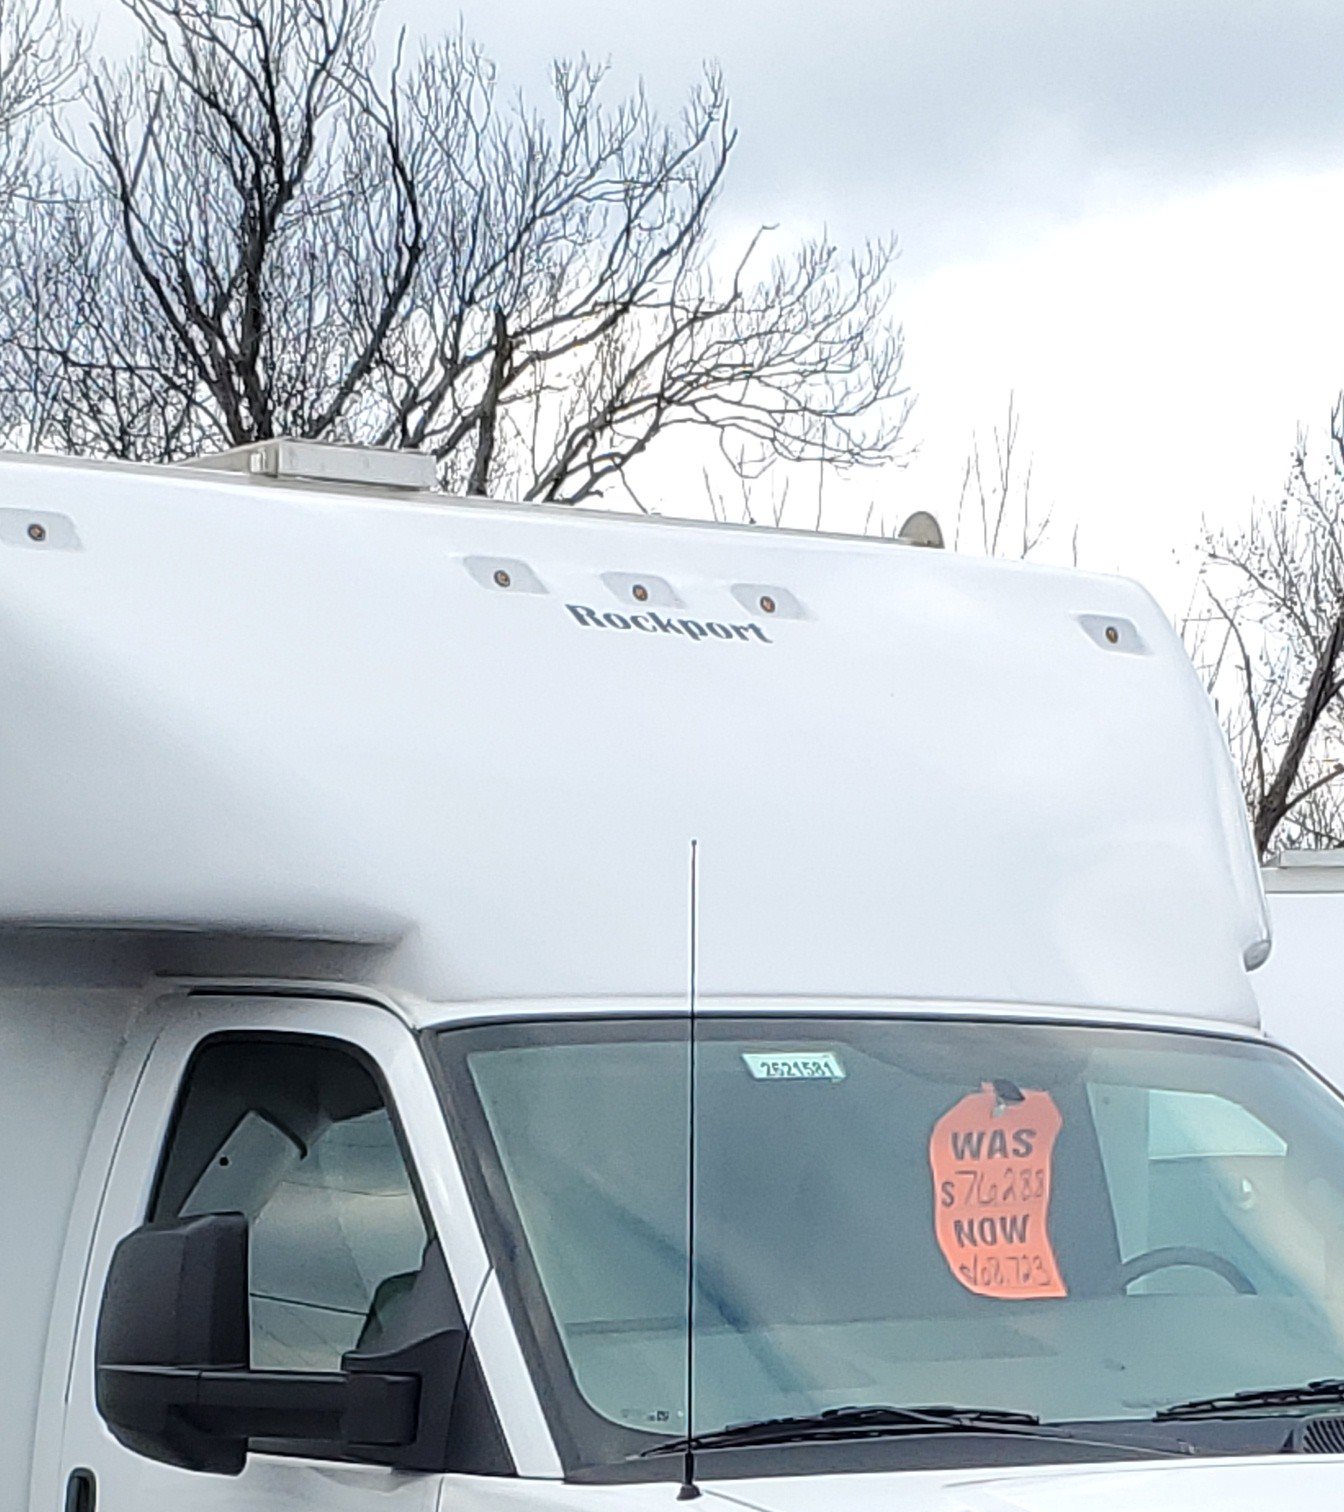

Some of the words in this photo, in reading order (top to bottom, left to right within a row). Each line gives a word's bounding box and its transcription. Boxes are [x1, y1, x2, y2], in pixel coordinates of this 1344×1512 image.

[565, 603, 774, 644] Rockport
[950, 1128, 1038, 1161] WAS
[953, 1214, 1030, 1248] NOW
